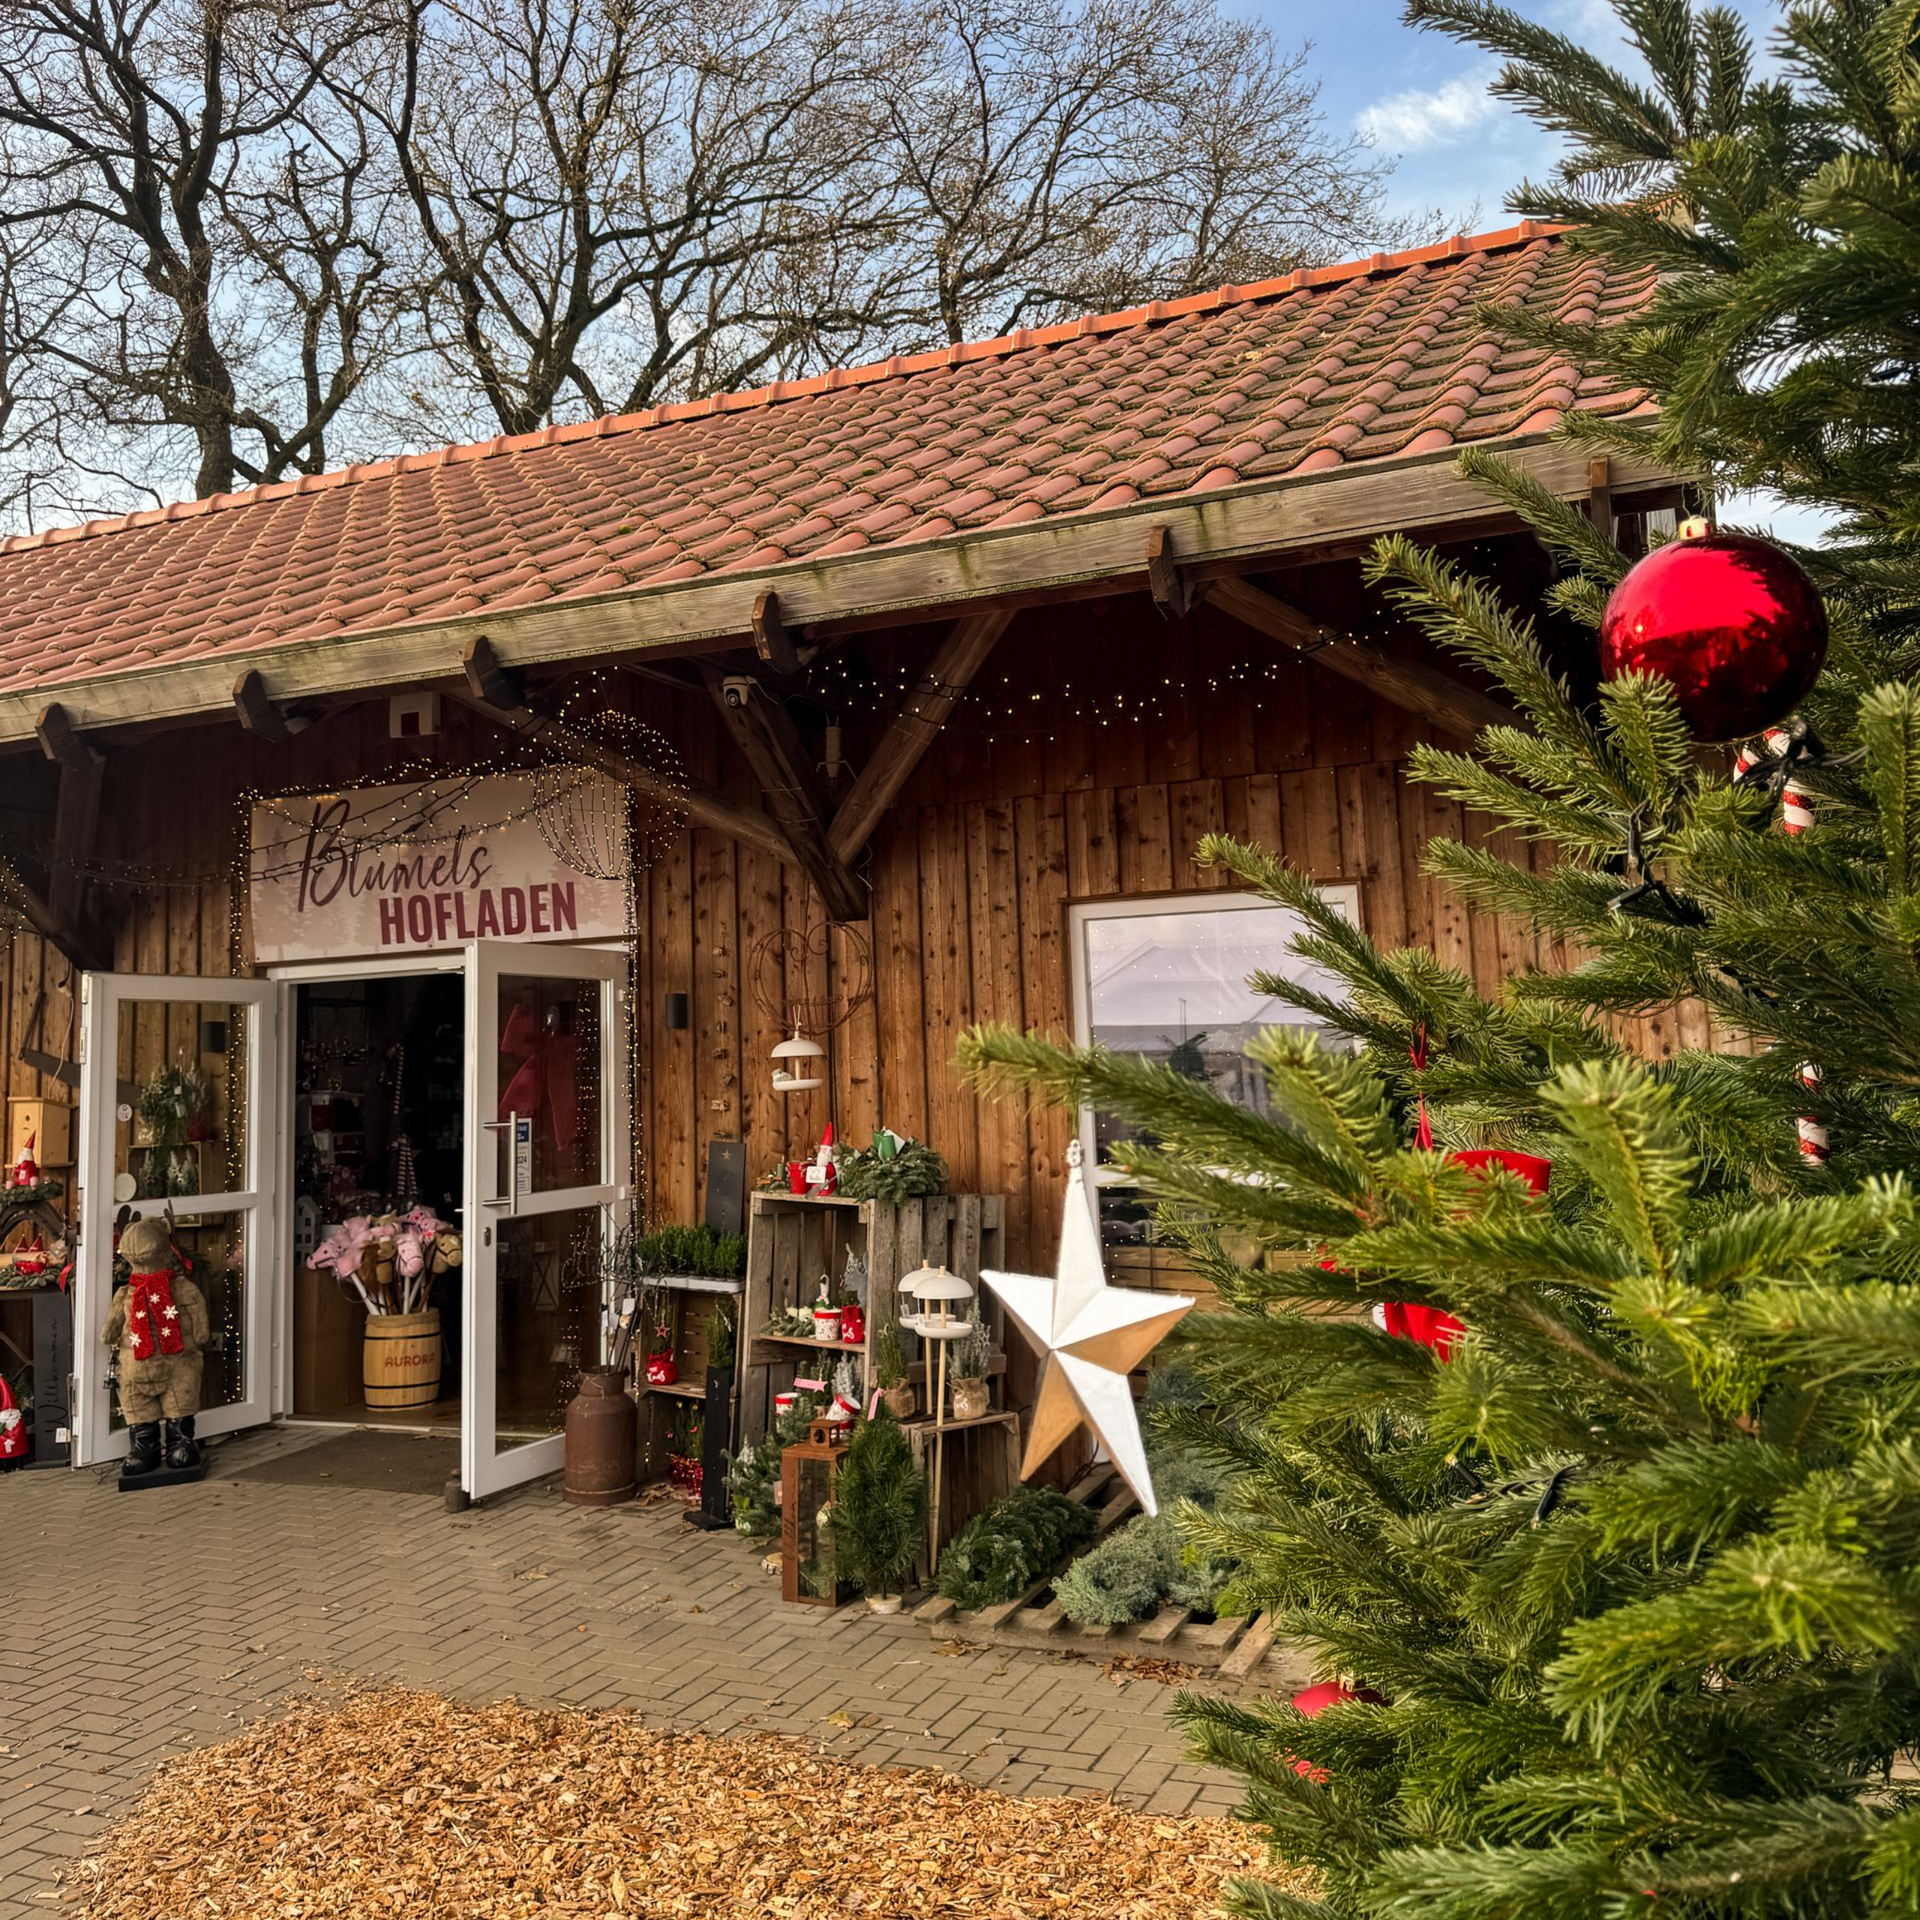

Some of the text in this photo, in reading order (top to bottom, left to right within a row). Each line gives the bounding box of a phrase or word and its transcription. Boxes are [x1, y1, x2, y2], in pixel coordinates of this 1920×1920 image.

[298, 799, 492, 913] Blumels
[379, 882, 577, 945] HOFLADEN
[385, 1353, 435, 1368] AURORA
